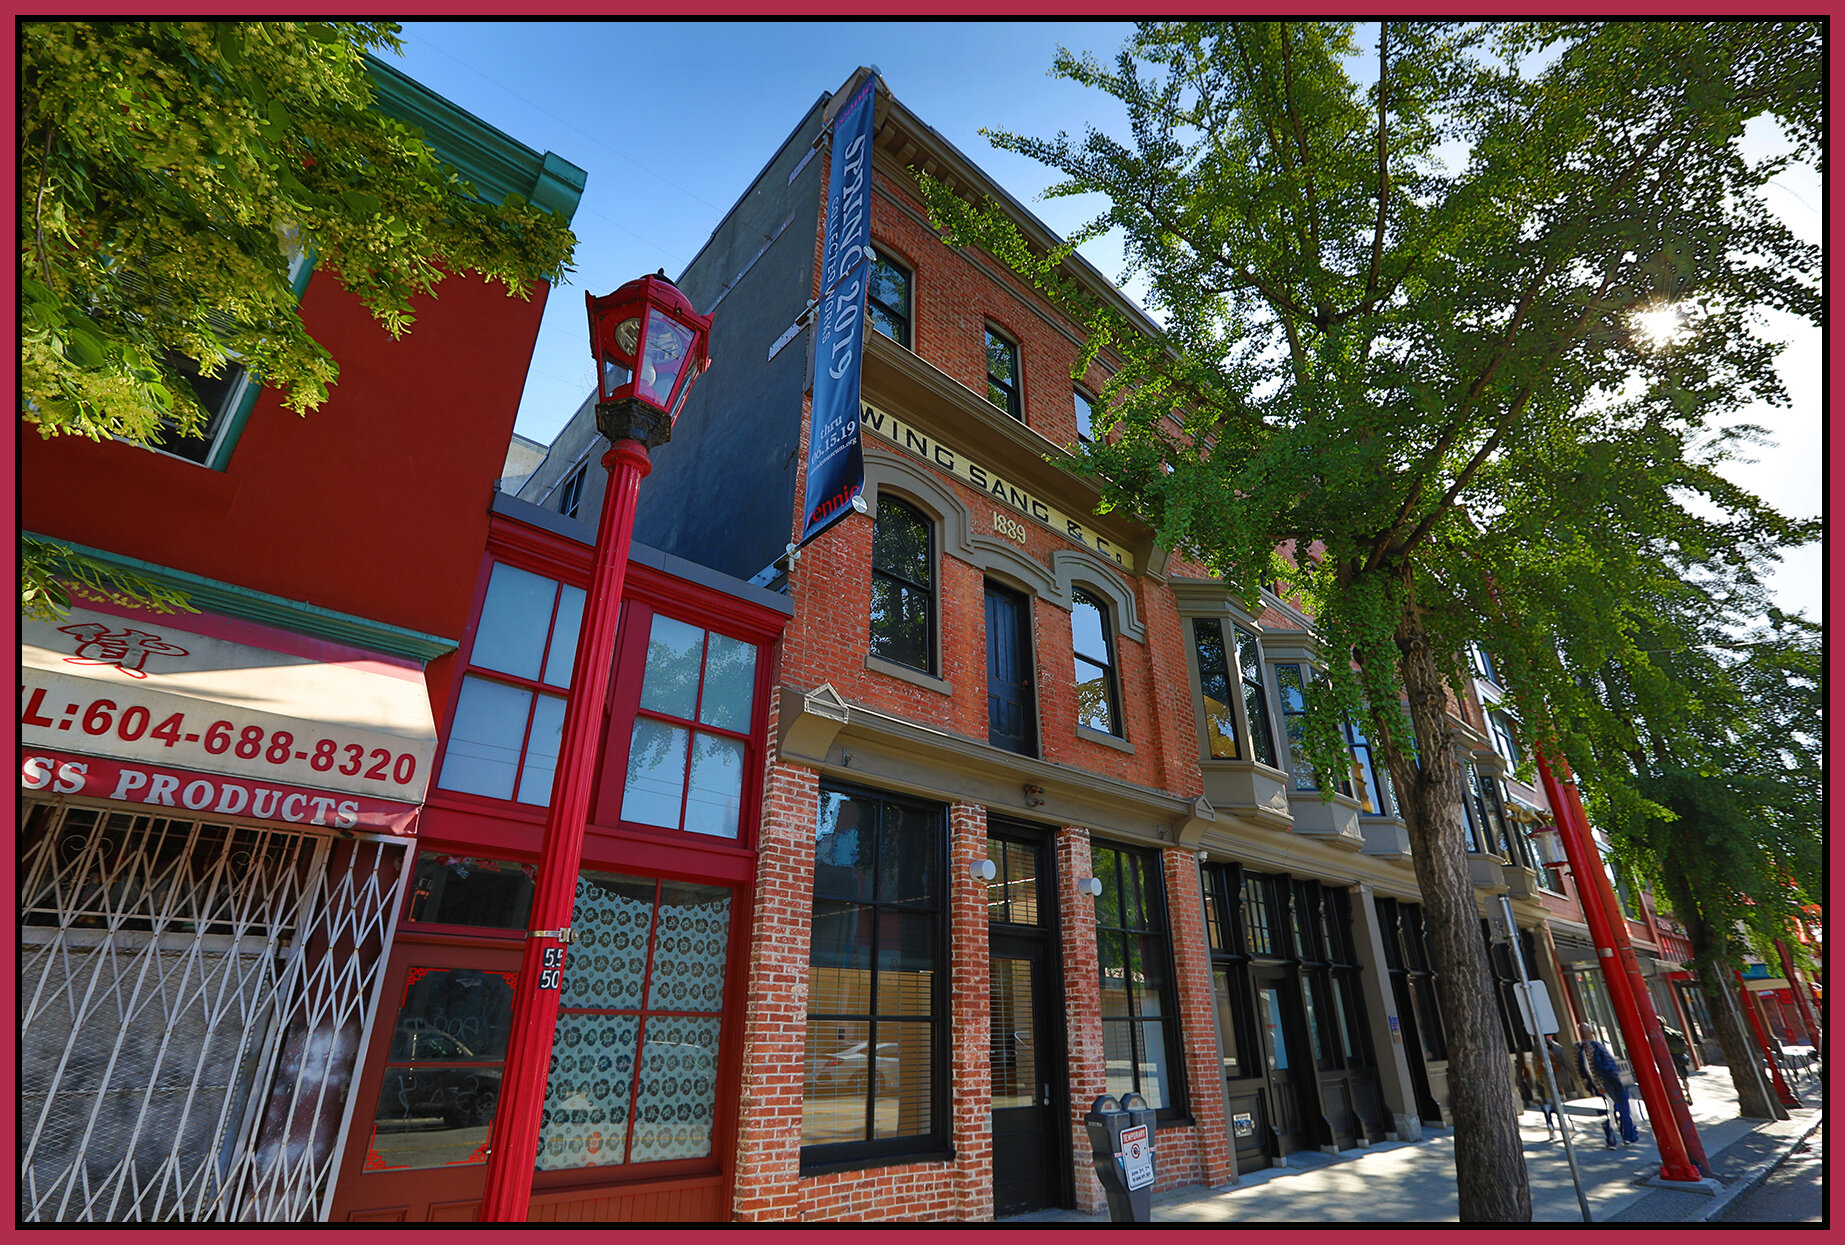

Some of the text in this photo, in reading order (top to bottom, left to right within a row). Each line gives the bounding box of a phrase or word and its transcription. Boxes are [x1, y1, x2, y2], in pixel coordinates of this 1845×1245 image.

[839, 134, 865, 279] SPRING
[821, 197, 839, 344] COLLECTED WORKS
[829, 280, 860, 379] 2019
[811, 421, 856, 464] 06.15.19
[820, 416, 842, 440] thru
[861, 400, 954, 471] WING
[970, 464, 1049, 523] SANG
[1067, 520, 1087, 545] &
[806, 485, 860, 528] rennie
[993, 511, 1026, 544] 1889
[22, 685, 416, 785] L:604-688-8320
[110, 769, 358, 828] PRODUCTS
[541, 970, 560, 989] 50
